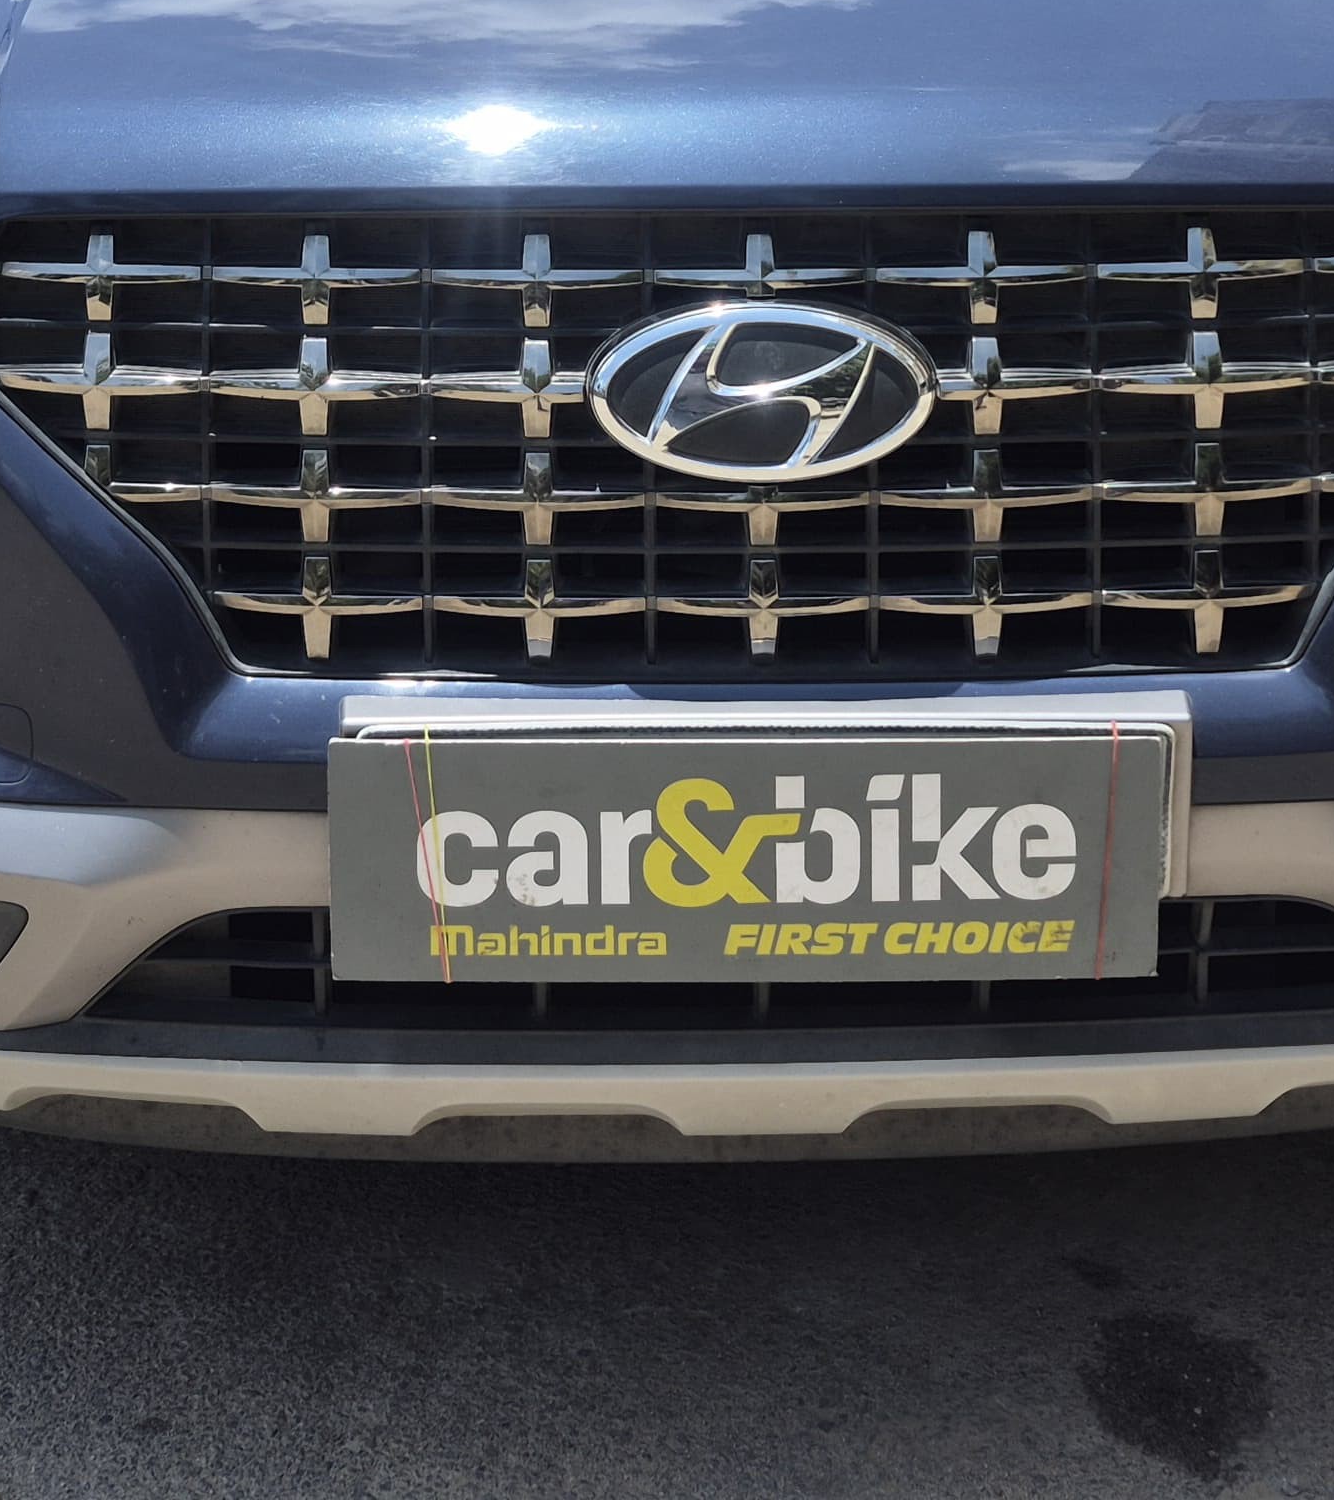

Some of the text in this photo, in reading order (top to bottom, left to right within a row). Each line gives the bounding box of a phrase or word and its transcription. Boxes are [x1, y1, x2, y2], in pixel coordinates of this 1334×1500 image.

[415, 773, 1077, 908] car&bike
[430, 925, 667, 957] Mahindra
[724, 919, 1075, 956] FIRST CHOICE
